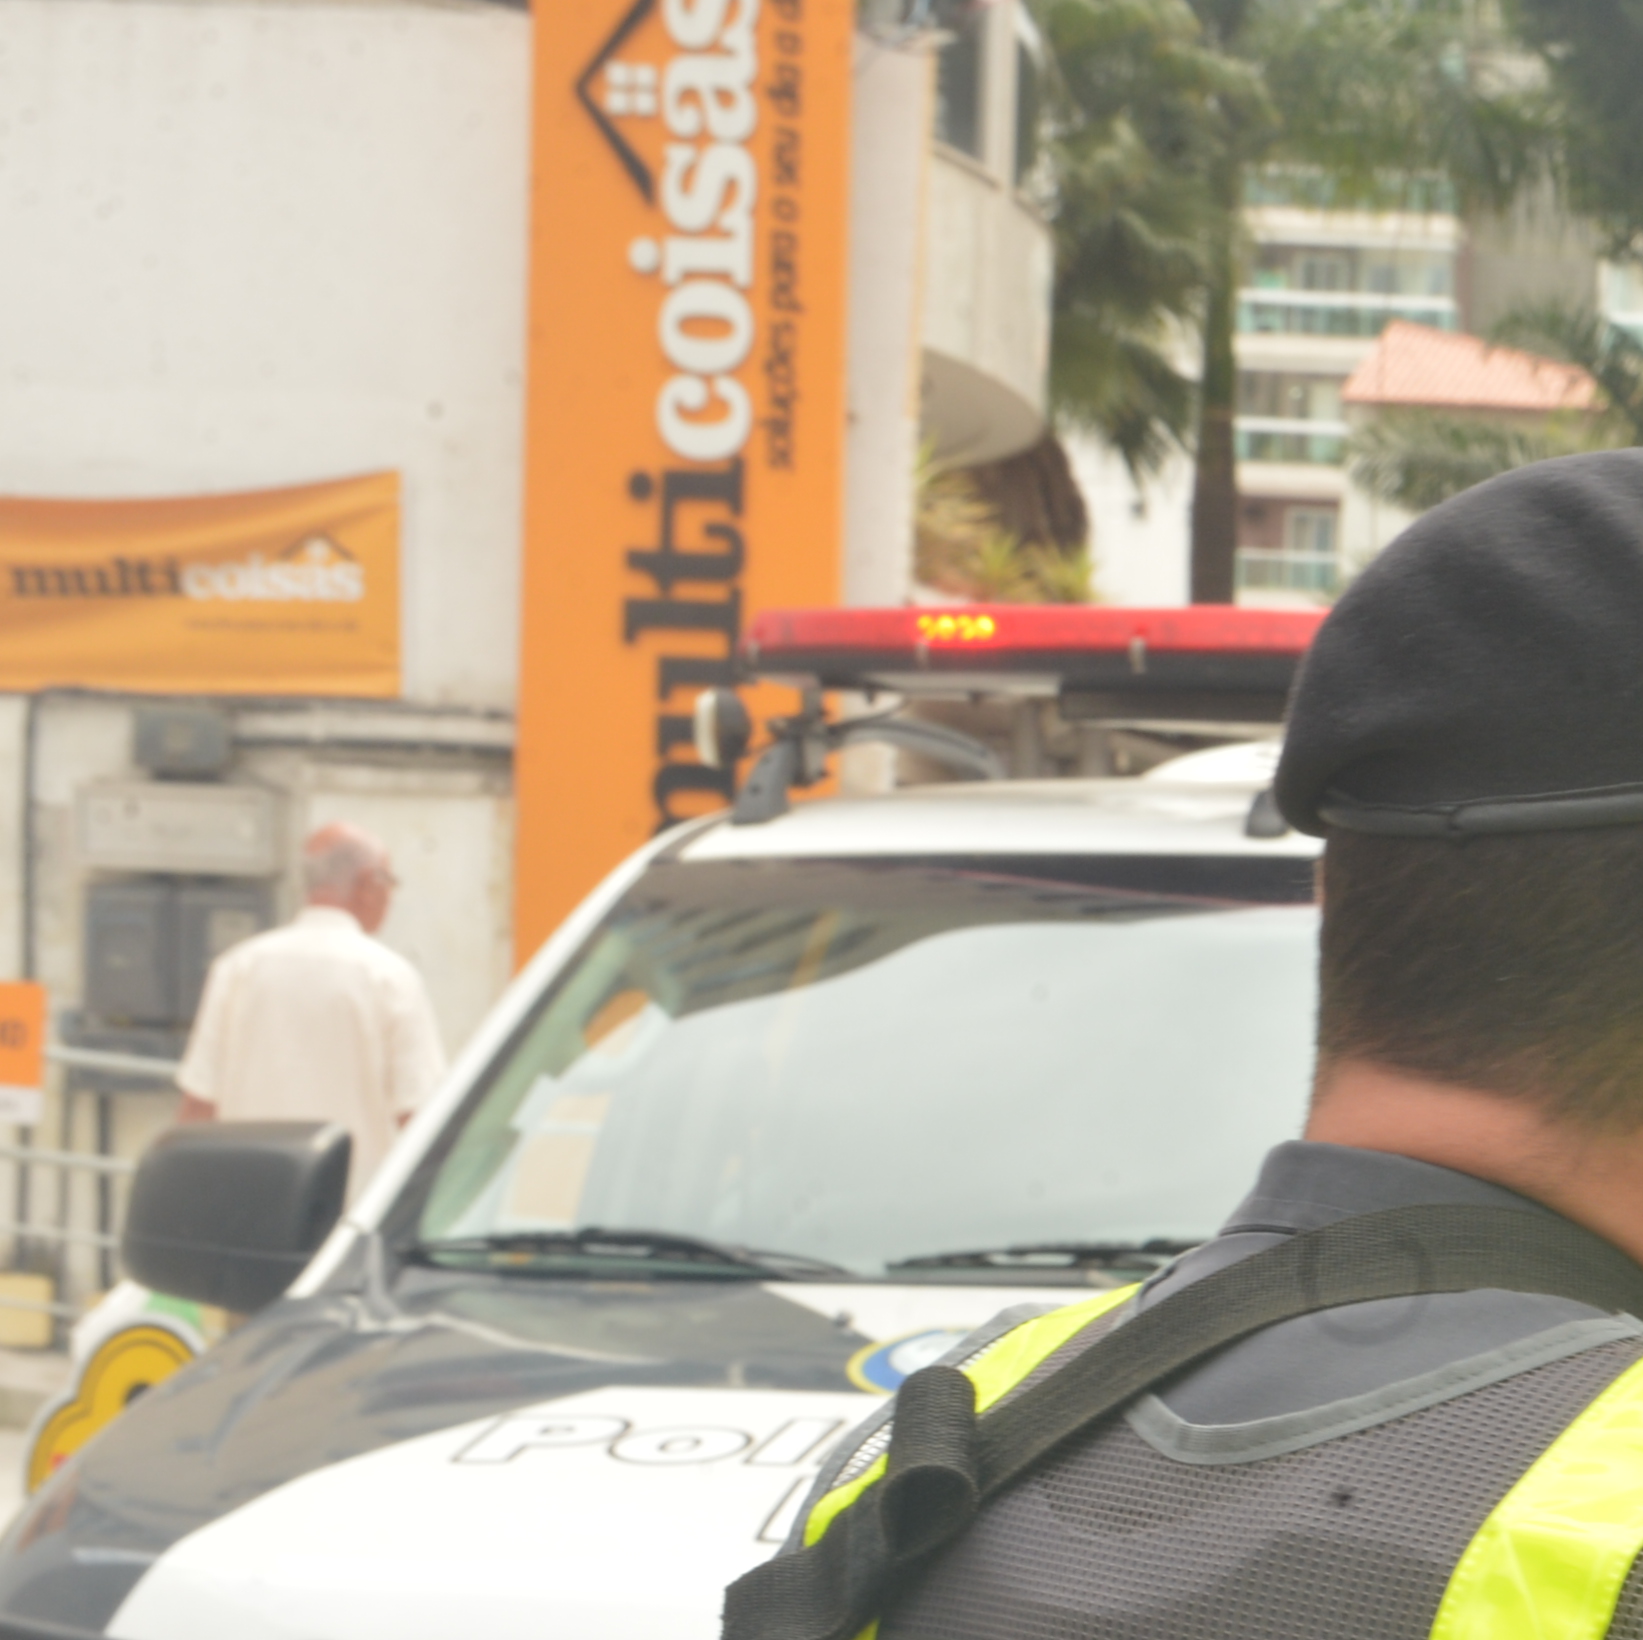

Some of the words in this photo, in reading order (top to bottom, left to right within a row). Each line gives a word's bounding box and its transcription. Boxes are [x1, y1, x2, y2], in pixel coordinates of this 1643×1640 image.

[772, 29, 802, 56] a
[765, 62, 802, 120] dia
[772, 126, 800, 187] seu
[770, 194, 800, 224] o
[768, 231, 806, 314] para
[11, 550, 365, 602] multicoisas
[449, 1415, 852, 1467] Pol
